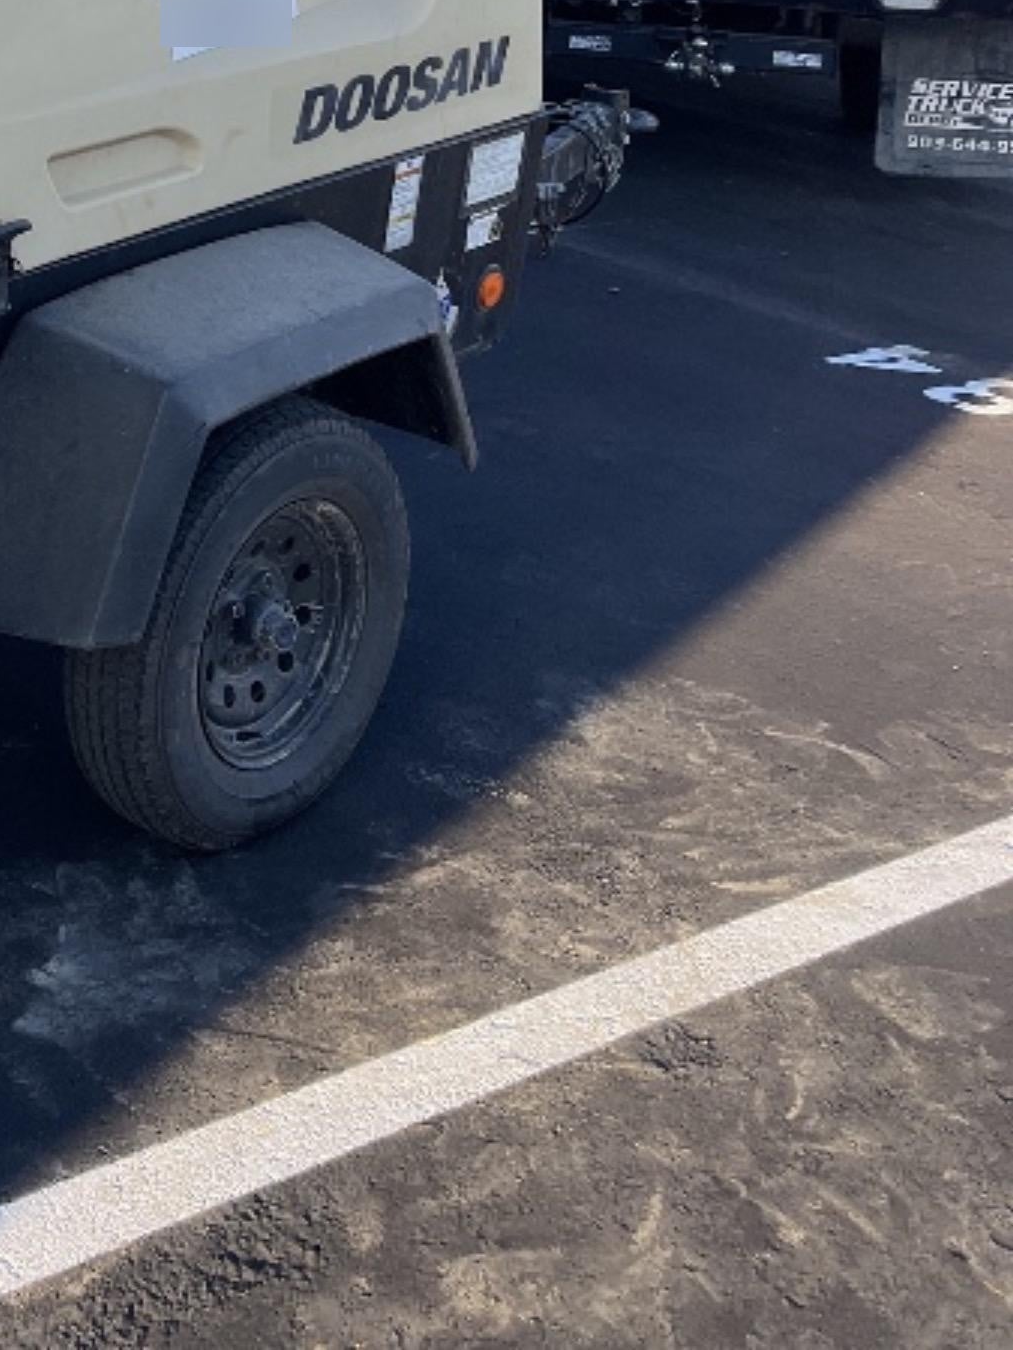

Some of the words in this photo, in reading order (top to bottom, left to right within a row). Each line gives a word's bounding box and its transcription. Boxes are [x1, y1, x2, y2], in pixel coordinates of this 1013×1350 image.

[292, 35, 510, 144] DOOSAN
[910, 77, 1013, 100] SERVICE
[907, 95, 987, 115] TRUCK
